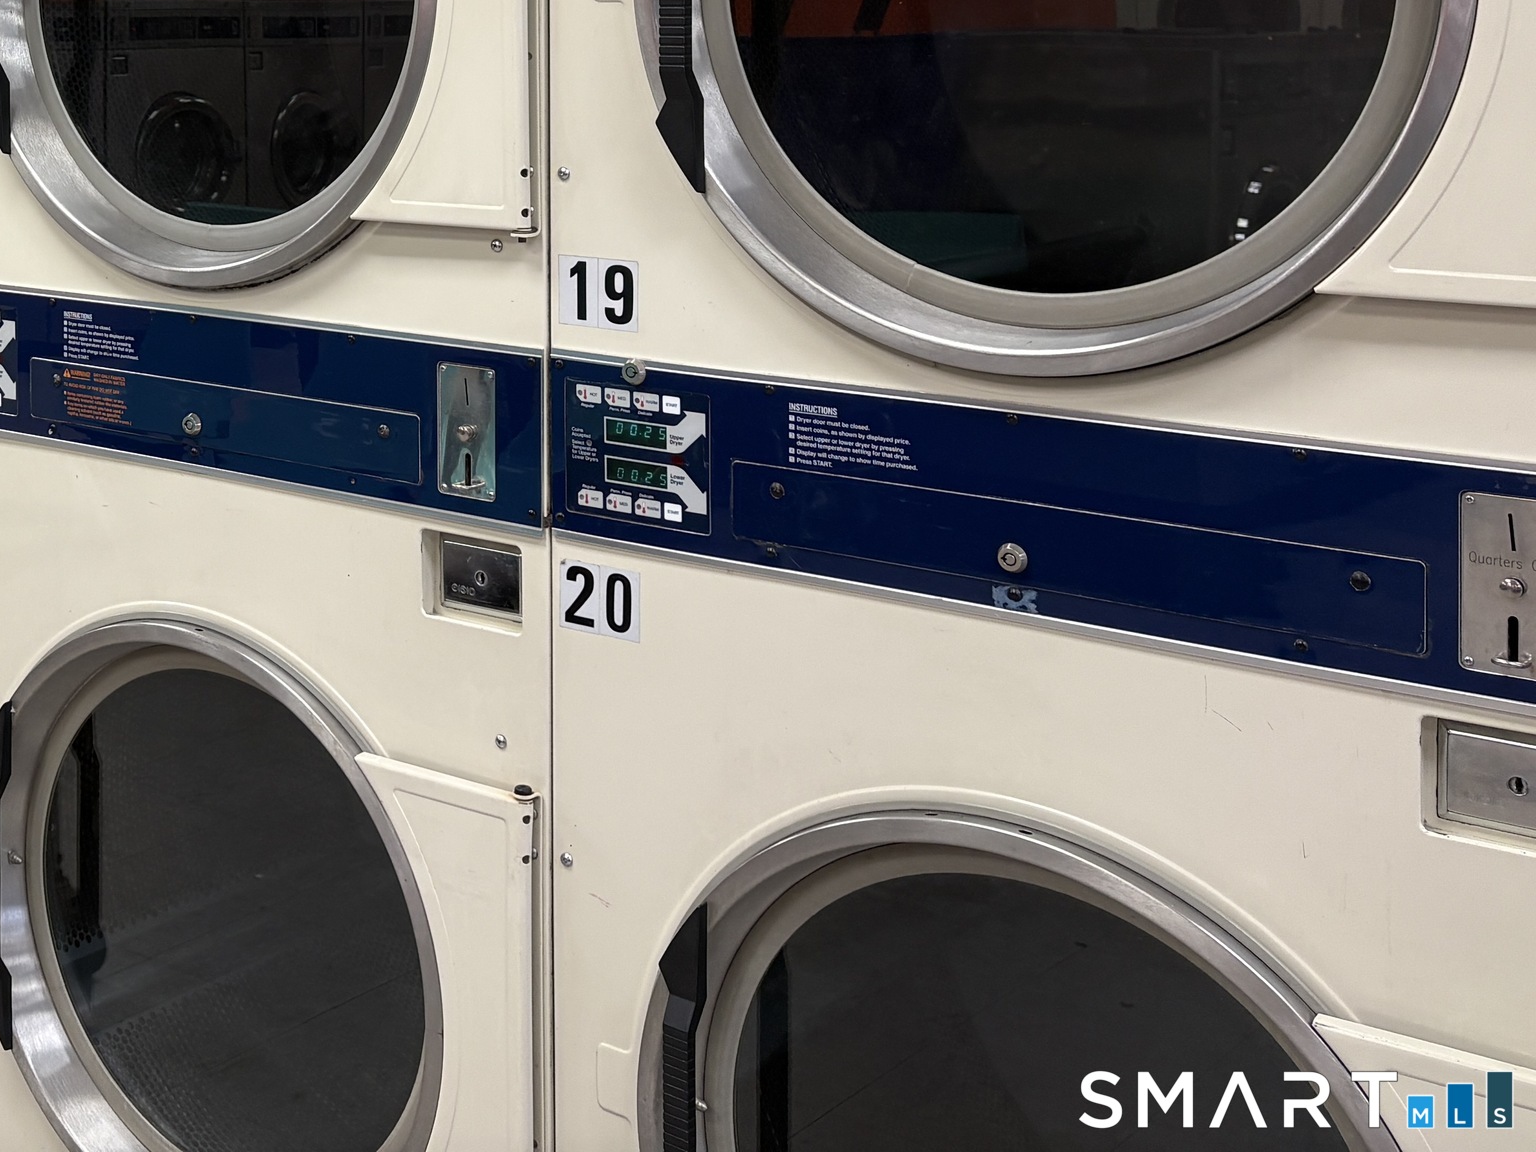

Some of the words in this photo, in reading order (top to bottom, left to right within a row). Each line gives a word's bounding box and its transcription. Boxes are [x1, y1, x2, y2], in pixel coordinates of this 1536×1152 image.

[569, 261, 634, 325] 19
[789, 402, 838, 417] INSTRUCTIONS
[796, 416, 812, 424] Dryer
[796, 433, 813, 441] Select
[854, 441, 870, 449] dryer
[871, 443, 879, 451] by
[879, 445, 904, 454] pressing
[866, 434, 894, 443] displayed
[796, 440, 817, 448] desired
[817, 443, 851, 453] temperature
[796, 448, 817, 458] Display
[828, 454, 849, 462] change
[796, 457, 812, 465] Press
[670, 478, 684, 486] Dryer
[1468, 550, 1523, 570] Quarters
[565, 566, 632, 634] 20
